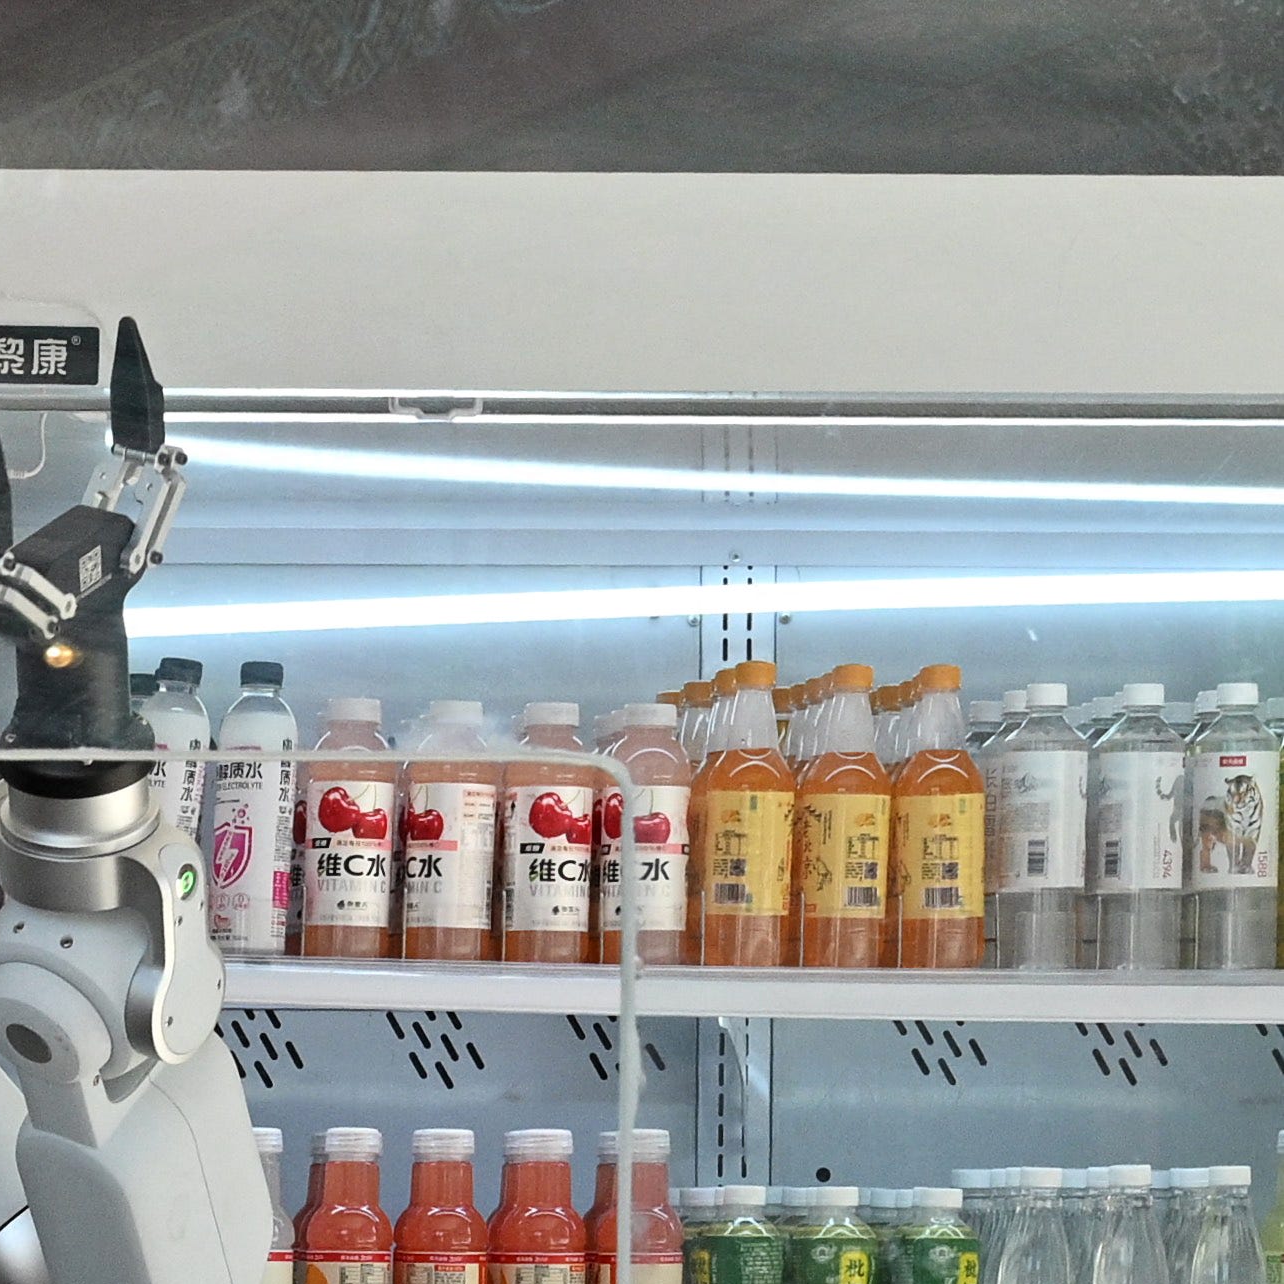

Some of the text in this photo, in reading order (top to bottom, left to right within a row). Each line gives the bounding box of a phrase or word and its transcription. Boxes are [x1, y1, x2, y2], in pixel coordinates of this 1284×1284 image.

[317, 852, 386, 877] 维C水
[1162, 849, 1173, 880] 4394
[1257, 850, 1268, 878] 1588
